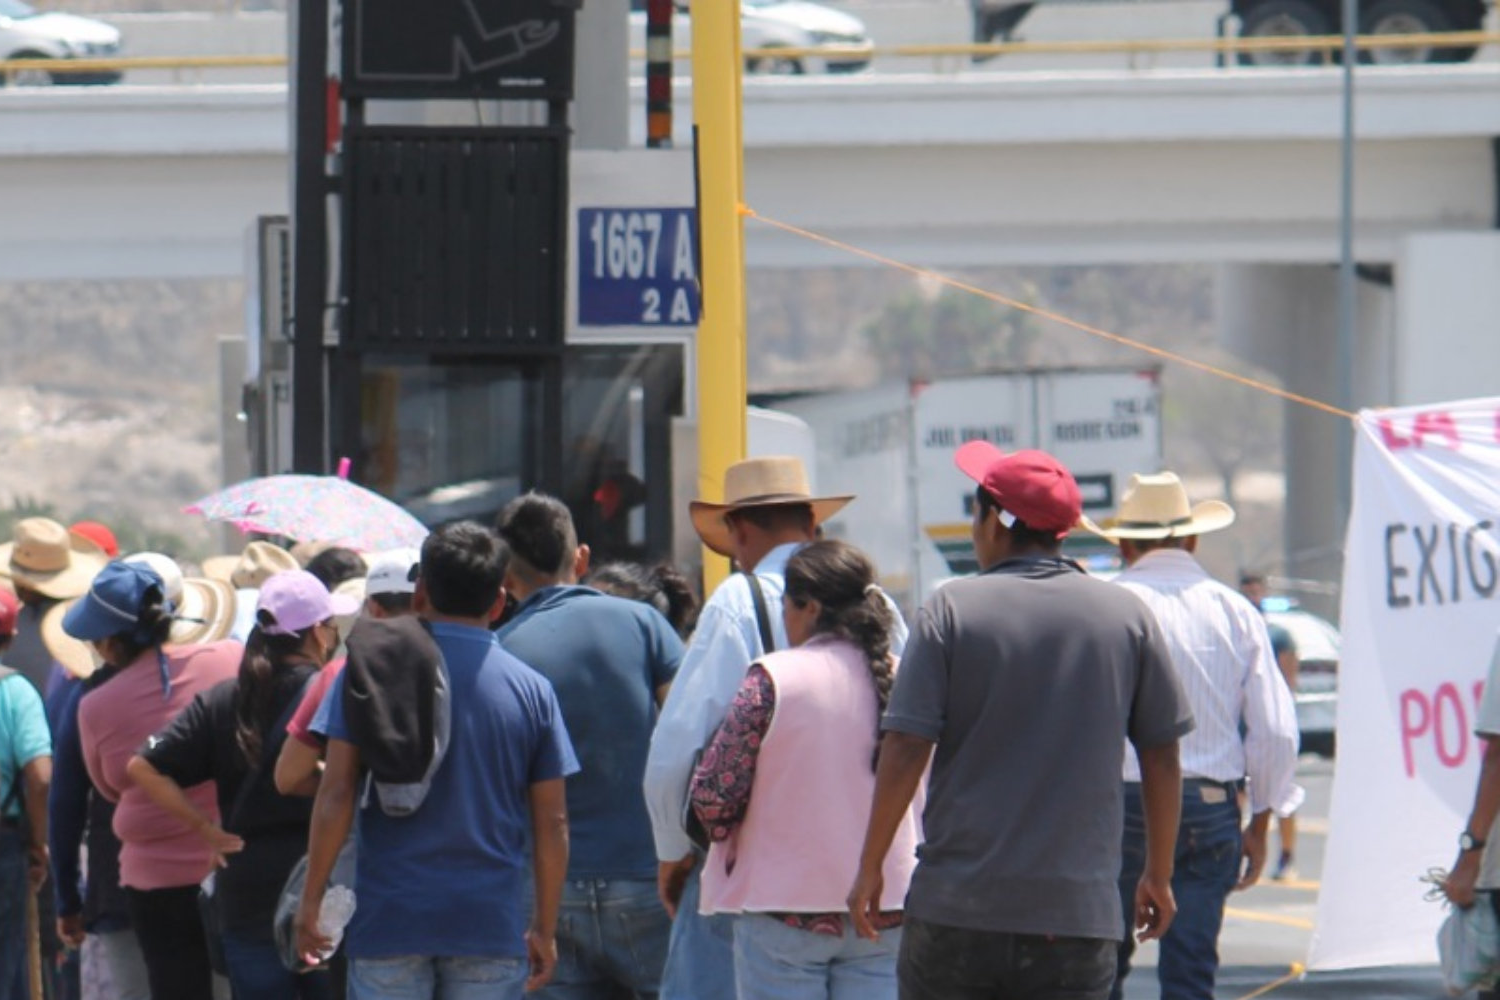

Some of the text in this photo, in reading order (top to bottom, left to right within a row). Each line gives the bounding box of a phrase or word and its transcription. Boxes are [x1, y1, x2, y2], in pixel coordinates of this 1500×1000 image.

[590, 212, 695, 281] 1667 A
[642, 288, 692, 322] 2 A
